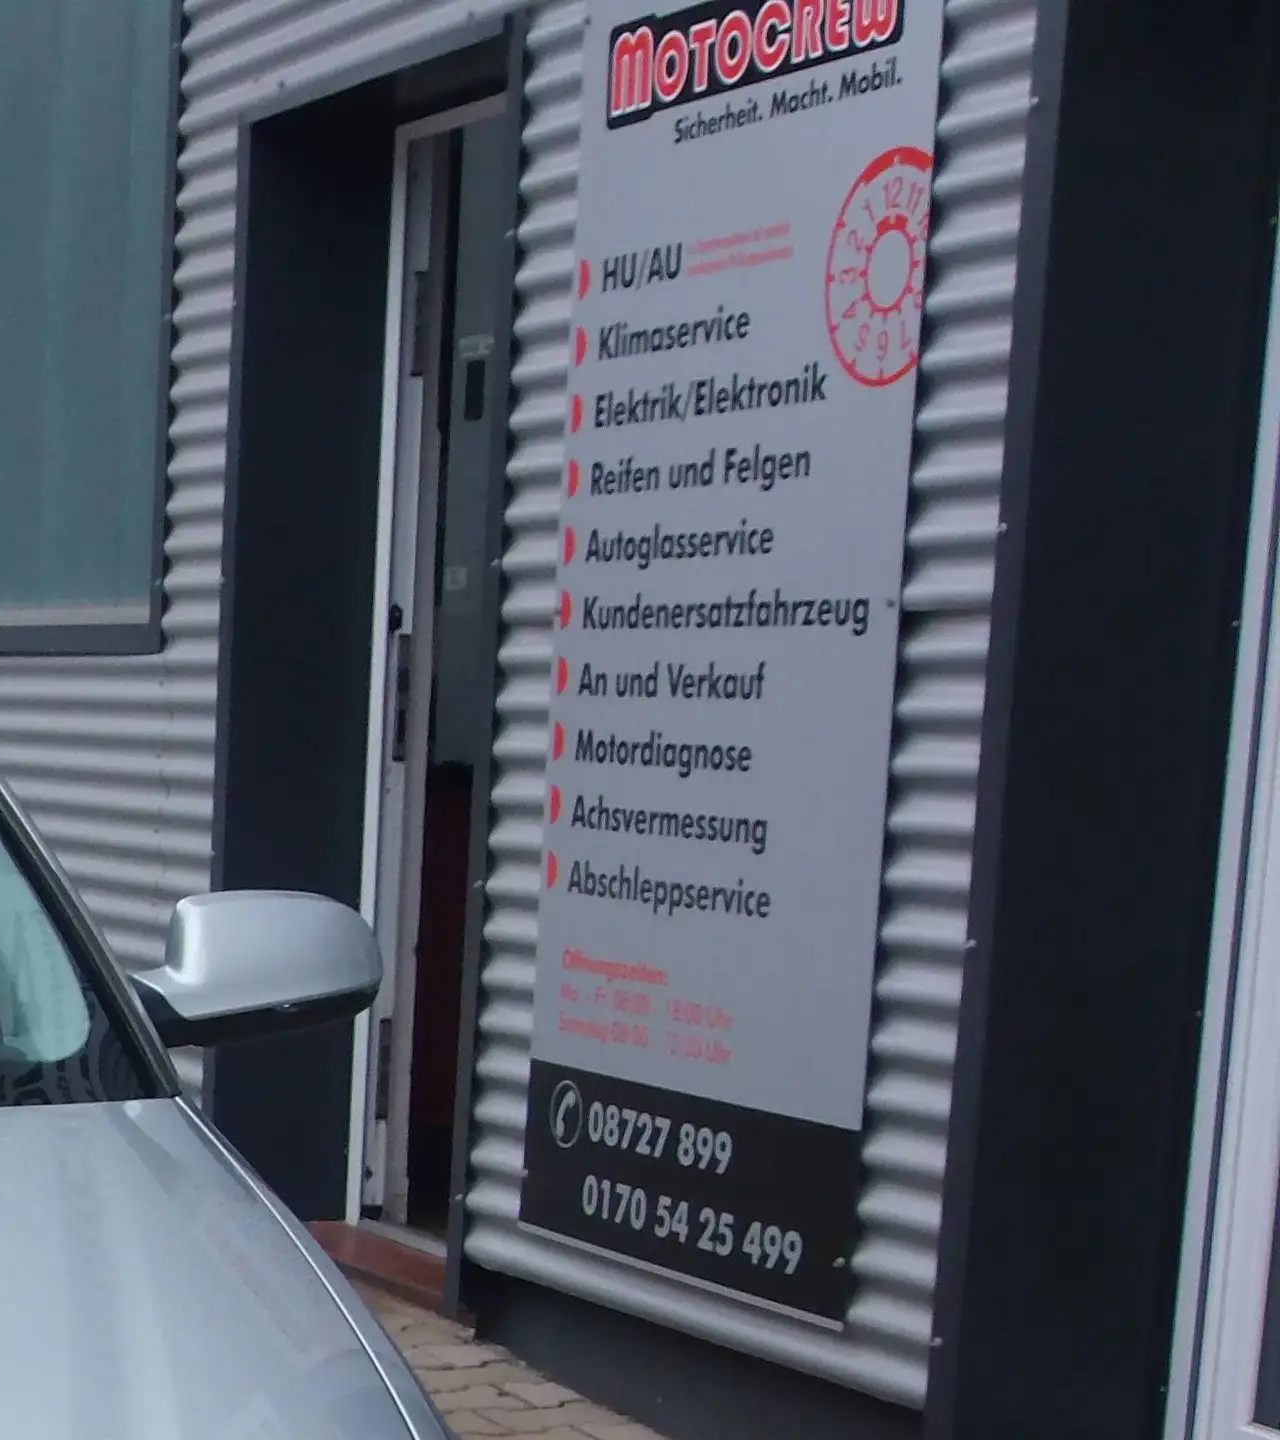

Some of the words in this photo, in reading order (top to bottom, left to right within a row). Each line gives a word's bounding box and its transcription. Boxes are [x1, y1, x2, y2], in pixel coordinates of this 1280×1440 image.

[674, 98, 763, 144] Sicherheit.
[768, 77, 833, 119] Macht.
[839, 56, 902, 100] Mobil.
[601, 242, 683, 293] HU/AU
[598, 304, 751, 360] Klimaservice
[594, 361, 828, 428] Elektrik/Elektronik
[590, 456, 660, 496] Reifen
[669, 448, 715, 489] und
[724, 444, 811, 491] Felgen
[585, 518, 774, 570] Autoglasservice
[582, 588, 870, 636] Kundenersatzfahrzeug
[578, 662, 607, 696] An
[616, 661, 660, 698] und
[667, 661, 767, 700] Verkauf
[575, 729, 752, 778] Motordiagnose
[571, 795, 768, 855] Achsvermessung
[568, 860, 771, 918] Abschleppservice
[589, 1101, 672, 1158] 08727
[677, 1123, 733, 1175] 899
[582, 1174, 647, 1230] 0170
[653, 1195, 689, 1244] 54
[697, 1207, 735, 1256] 25
[741, 1221, 803, 1275] 499
